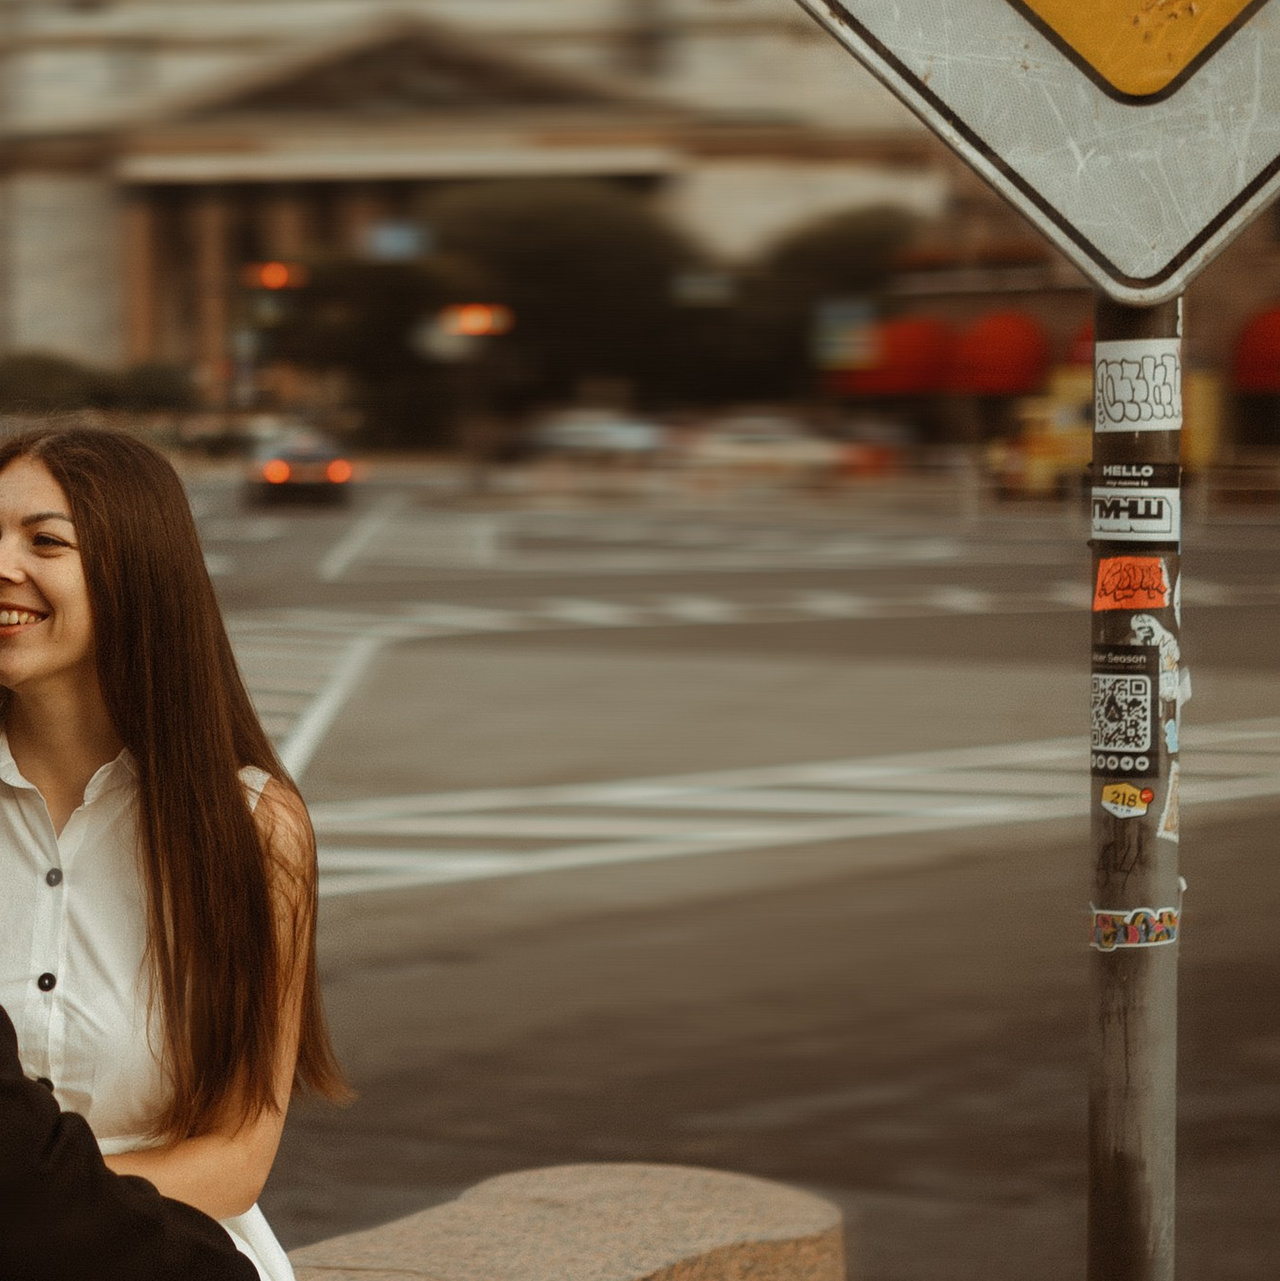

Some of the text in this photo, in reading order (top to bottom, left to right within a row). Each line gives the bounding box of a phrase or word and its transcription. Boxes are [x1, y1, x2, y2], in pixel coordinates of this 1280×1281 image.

[1103, 465, 1154, 477] HELLO
[1107, 652, 1147, 664] Season
[1110, 790, 1138, 808] 218
